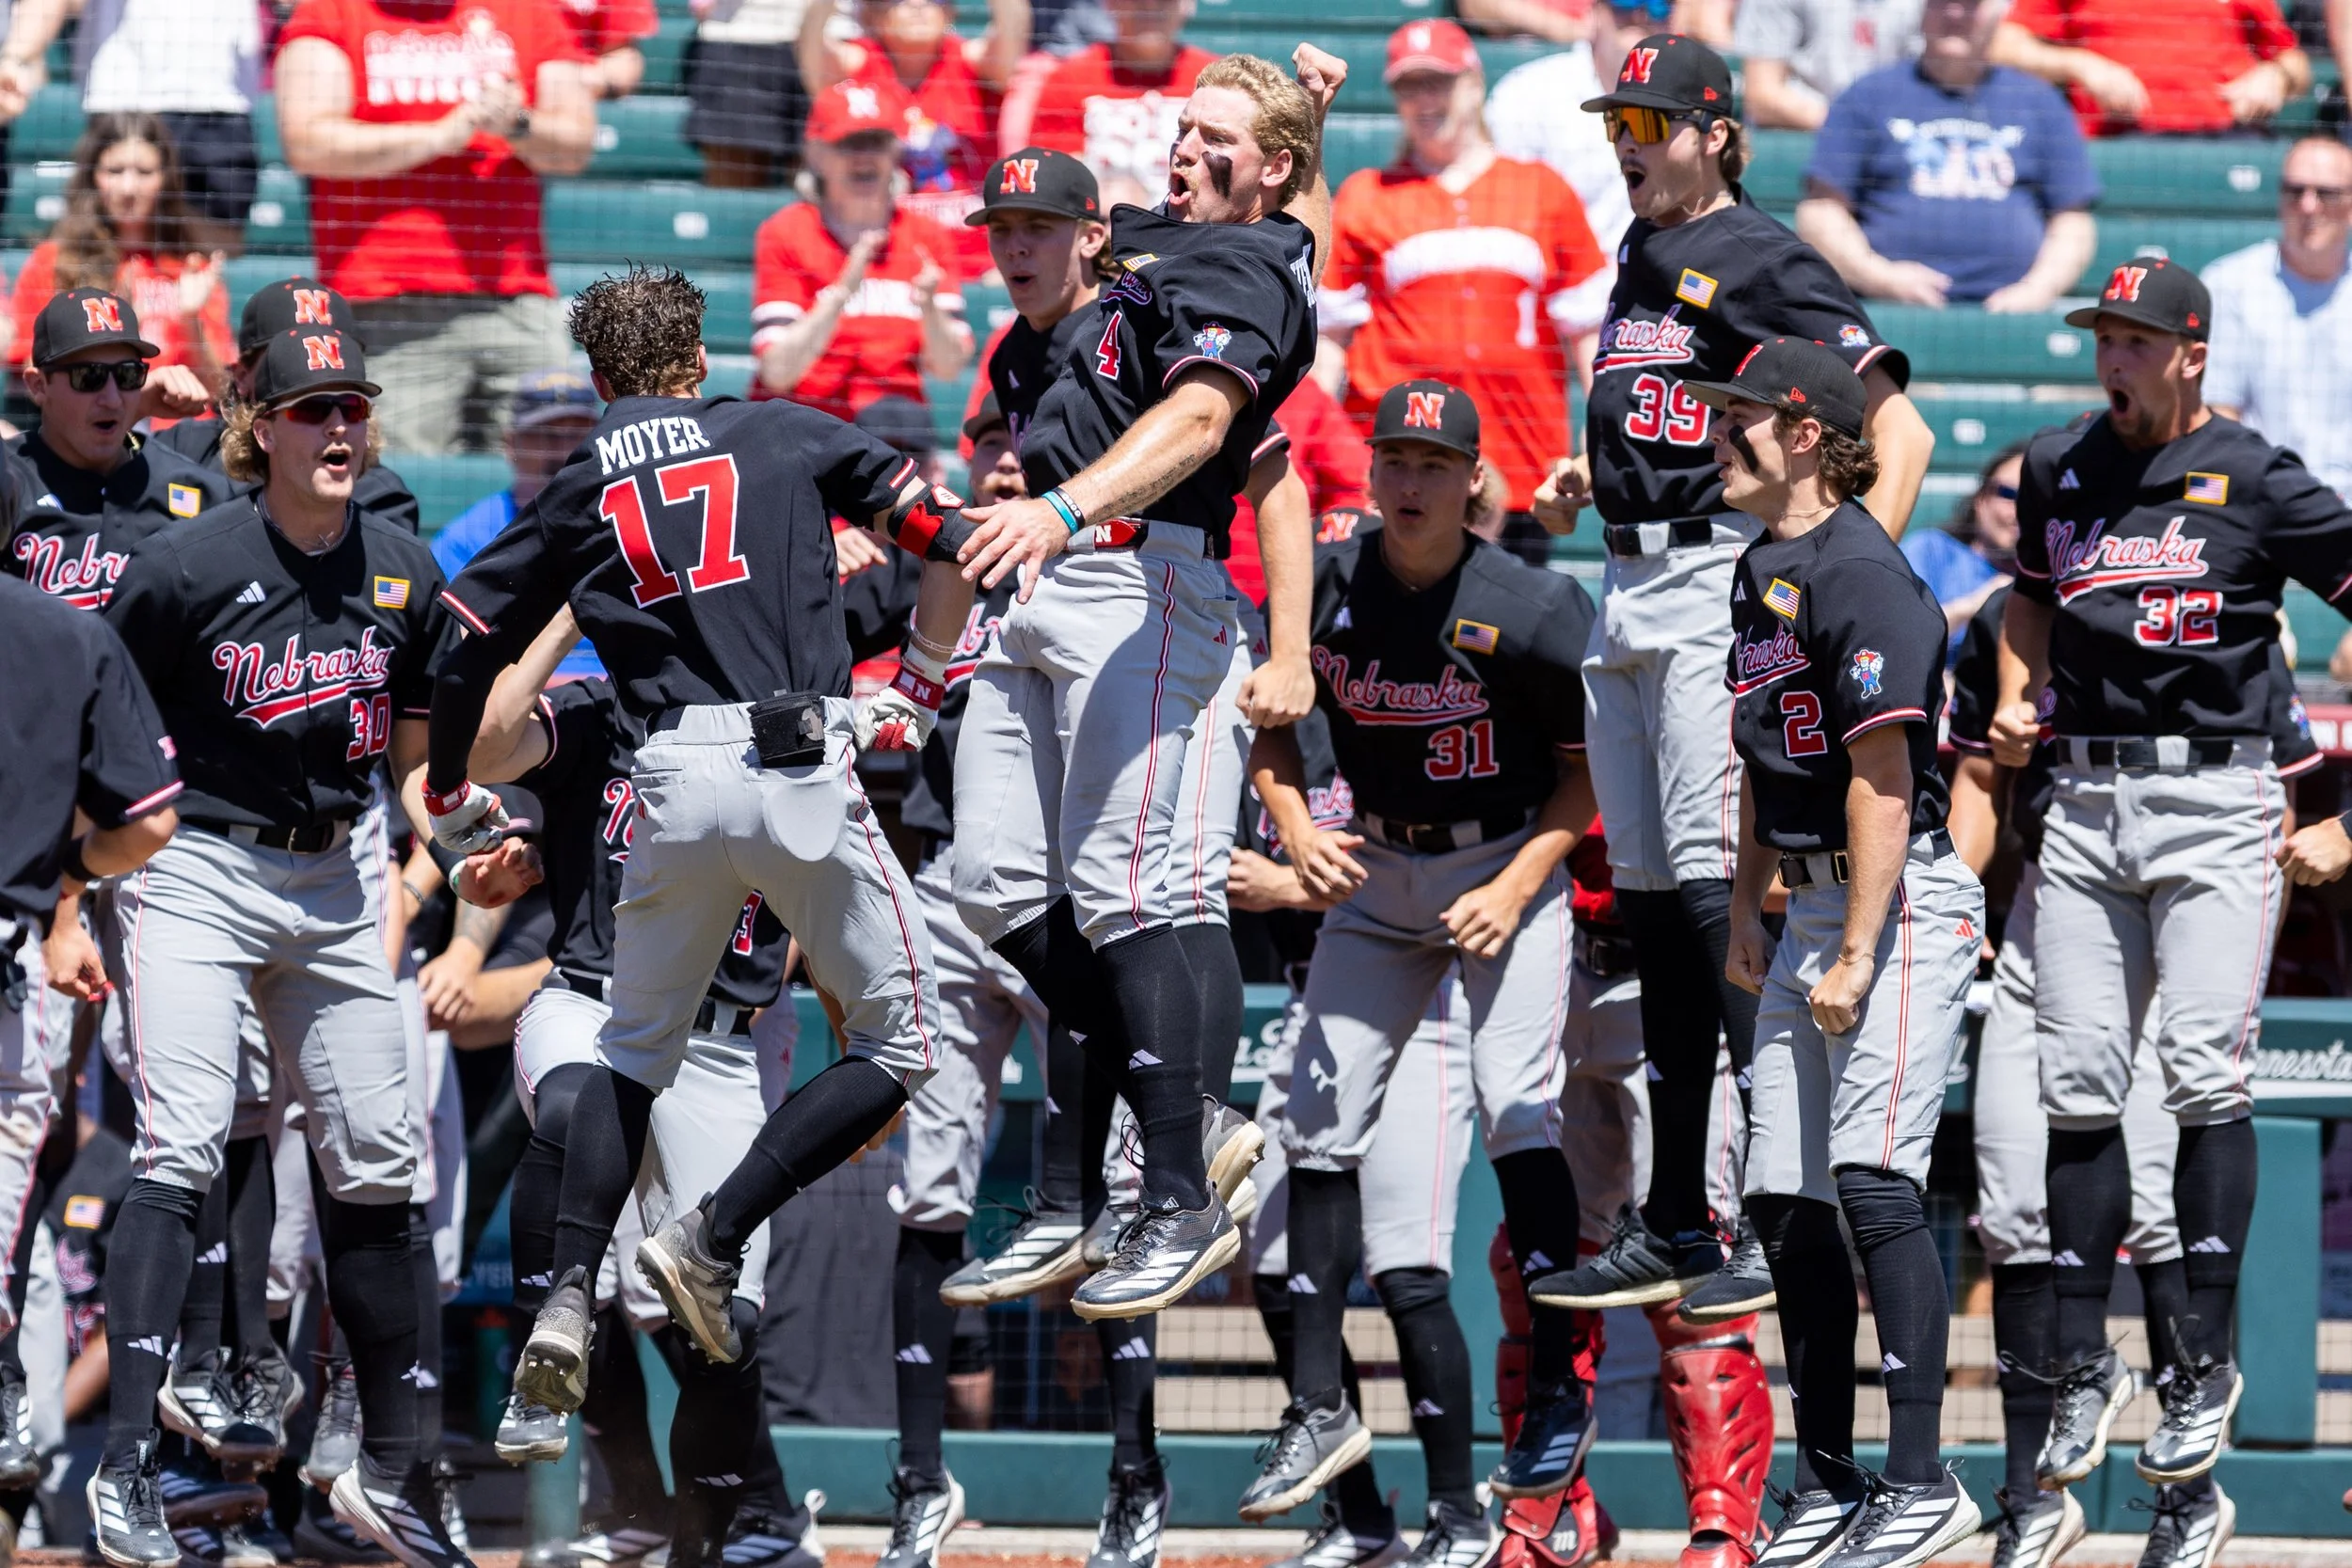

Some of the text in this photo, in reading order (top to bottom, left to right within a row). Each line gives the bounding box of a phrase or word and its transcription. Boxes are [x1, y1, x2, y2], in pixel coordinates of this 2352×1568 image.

[1620, 48, 1659, 84] N
[1000, 159, 1039, 194] N
[82, 296, 123, 332] N
[293, 289, 333, 325] N
[2105, 267, 2148, 303] N
[302, 335, 344, 371] N
[1096, 309, 1123, 381] 4
[1404, 391, 1445, 430] N
[1625, 372, 1711, 446] 39
[596, 416, 711, 476] MOYER
[598, 453, 751, 610] 17
[1095, 525, 1112, 543] N
[1316, 512, 1359, 544] N
[2046, 515, 2209, 583] Nebraska
[2134, 585, 2223, 646] 32
[212, 625, 396, 707] Nebraska
[914, 682, 931, 701] N
[1311, 644, 1490, 711] Nebraska
[346, 692, 390, 763] 30
[1424, 719, 1500, 781] 31
[1780, 690, 1828, 757] 2
